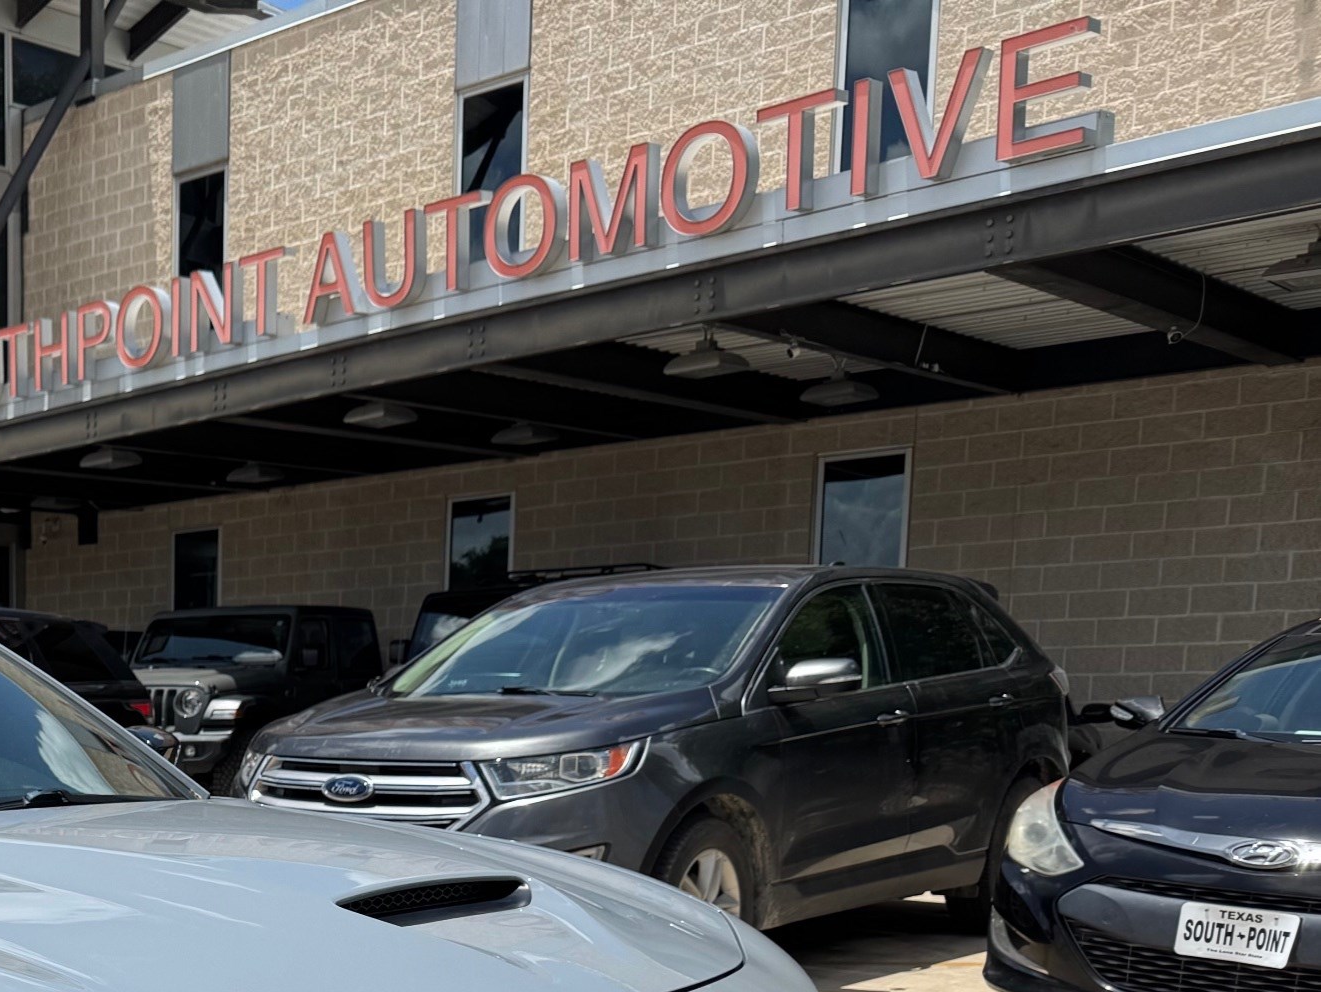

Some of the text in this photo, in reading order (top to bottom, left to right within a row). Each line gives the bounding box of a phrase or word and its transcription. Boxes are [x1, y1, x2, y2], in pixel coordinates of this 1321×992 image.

[302, 16, 1108, 326] AUTOMOTIVE
[1219, 909, 1263, 924] TEXAS
[1183, 918, 1291, 954] SOUTH POINT
